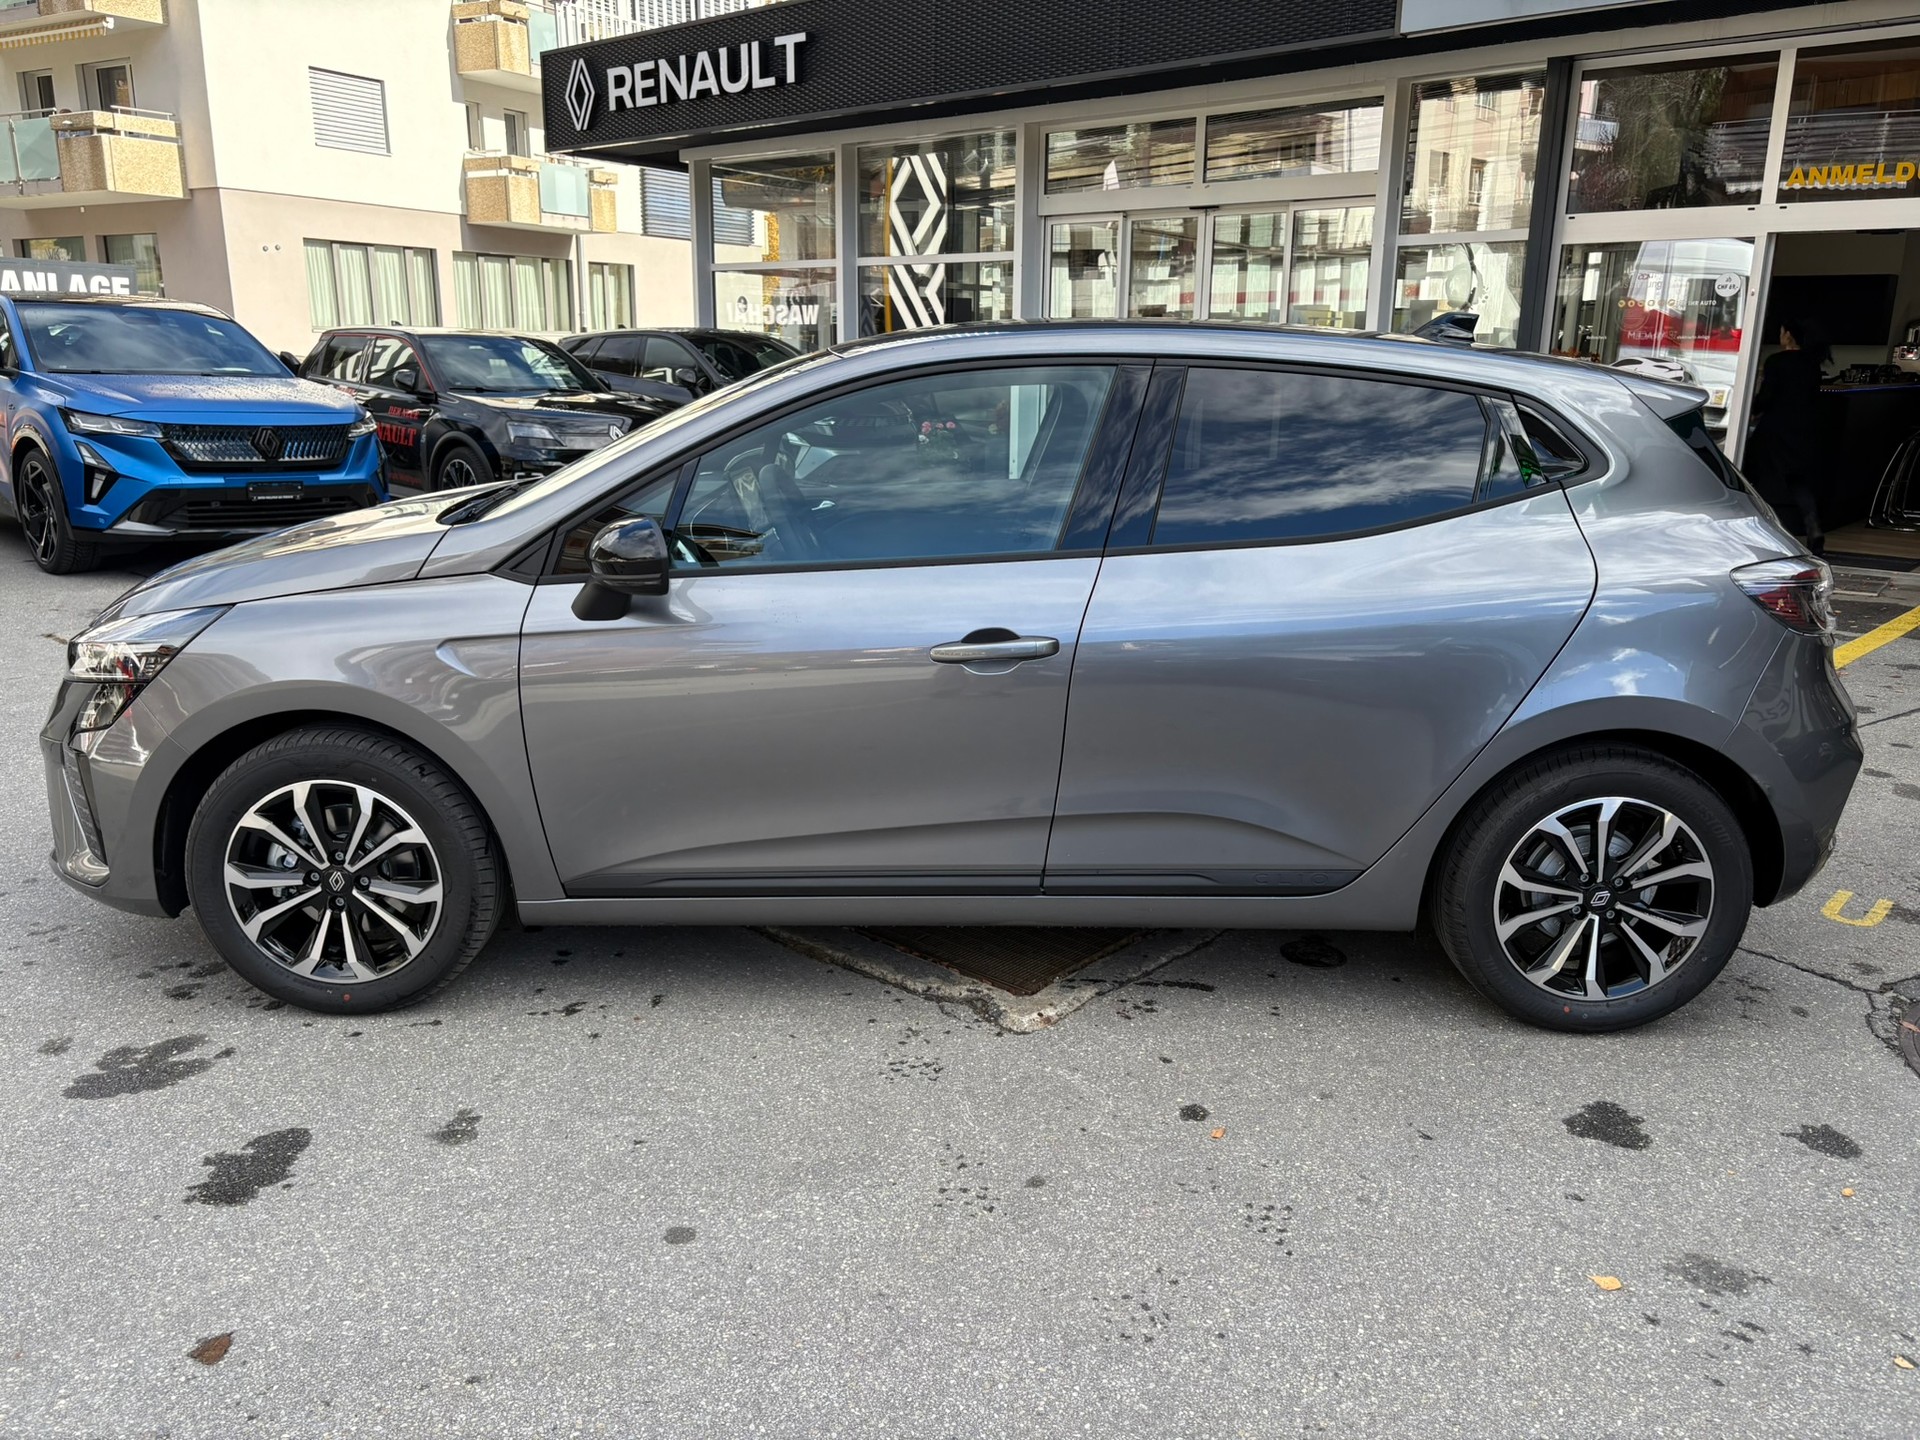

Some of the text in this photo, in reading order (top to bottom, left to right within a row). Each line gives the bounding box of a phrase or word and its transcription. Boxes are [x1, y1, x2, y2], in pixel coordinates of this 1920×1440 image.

[606, 32, 806, 112] RENAULT
[1786, 161, 1920, 187] ANMELD
[376, 421, 417, 446] NAULT
